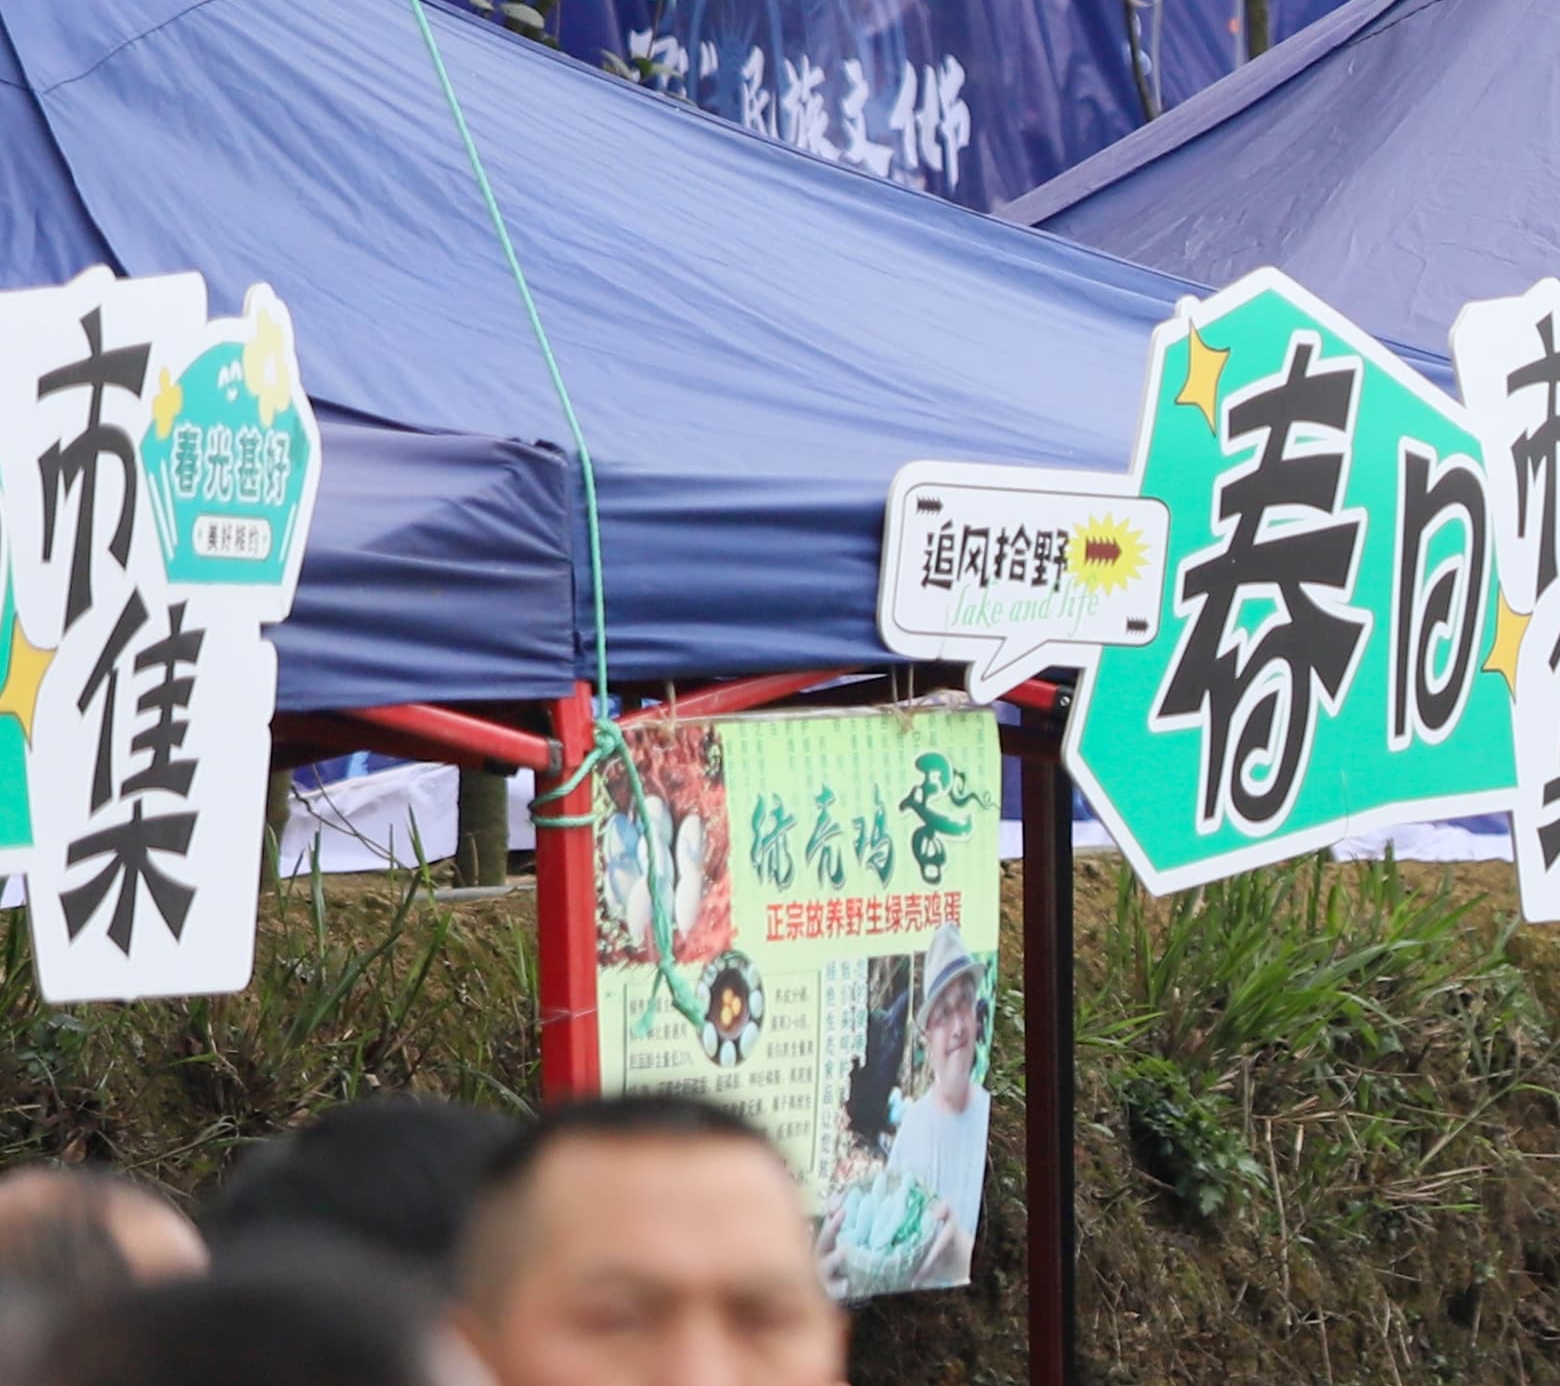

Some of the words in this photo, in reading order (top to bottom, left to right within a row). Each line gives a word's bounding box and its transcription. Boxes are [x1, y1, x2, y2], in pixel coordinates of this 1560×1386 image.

[171, 422, 290, 506] 春光甚好
[921, 519, 1069, 592] 追风拾野
[1158, 344, 1486, 819] 春日
[38, 307, 206, 957] 市集
[1010, 587, 1054, 623] and
[766, 891, 963, 943] 正宗放养野生绿壳鸡蛋
